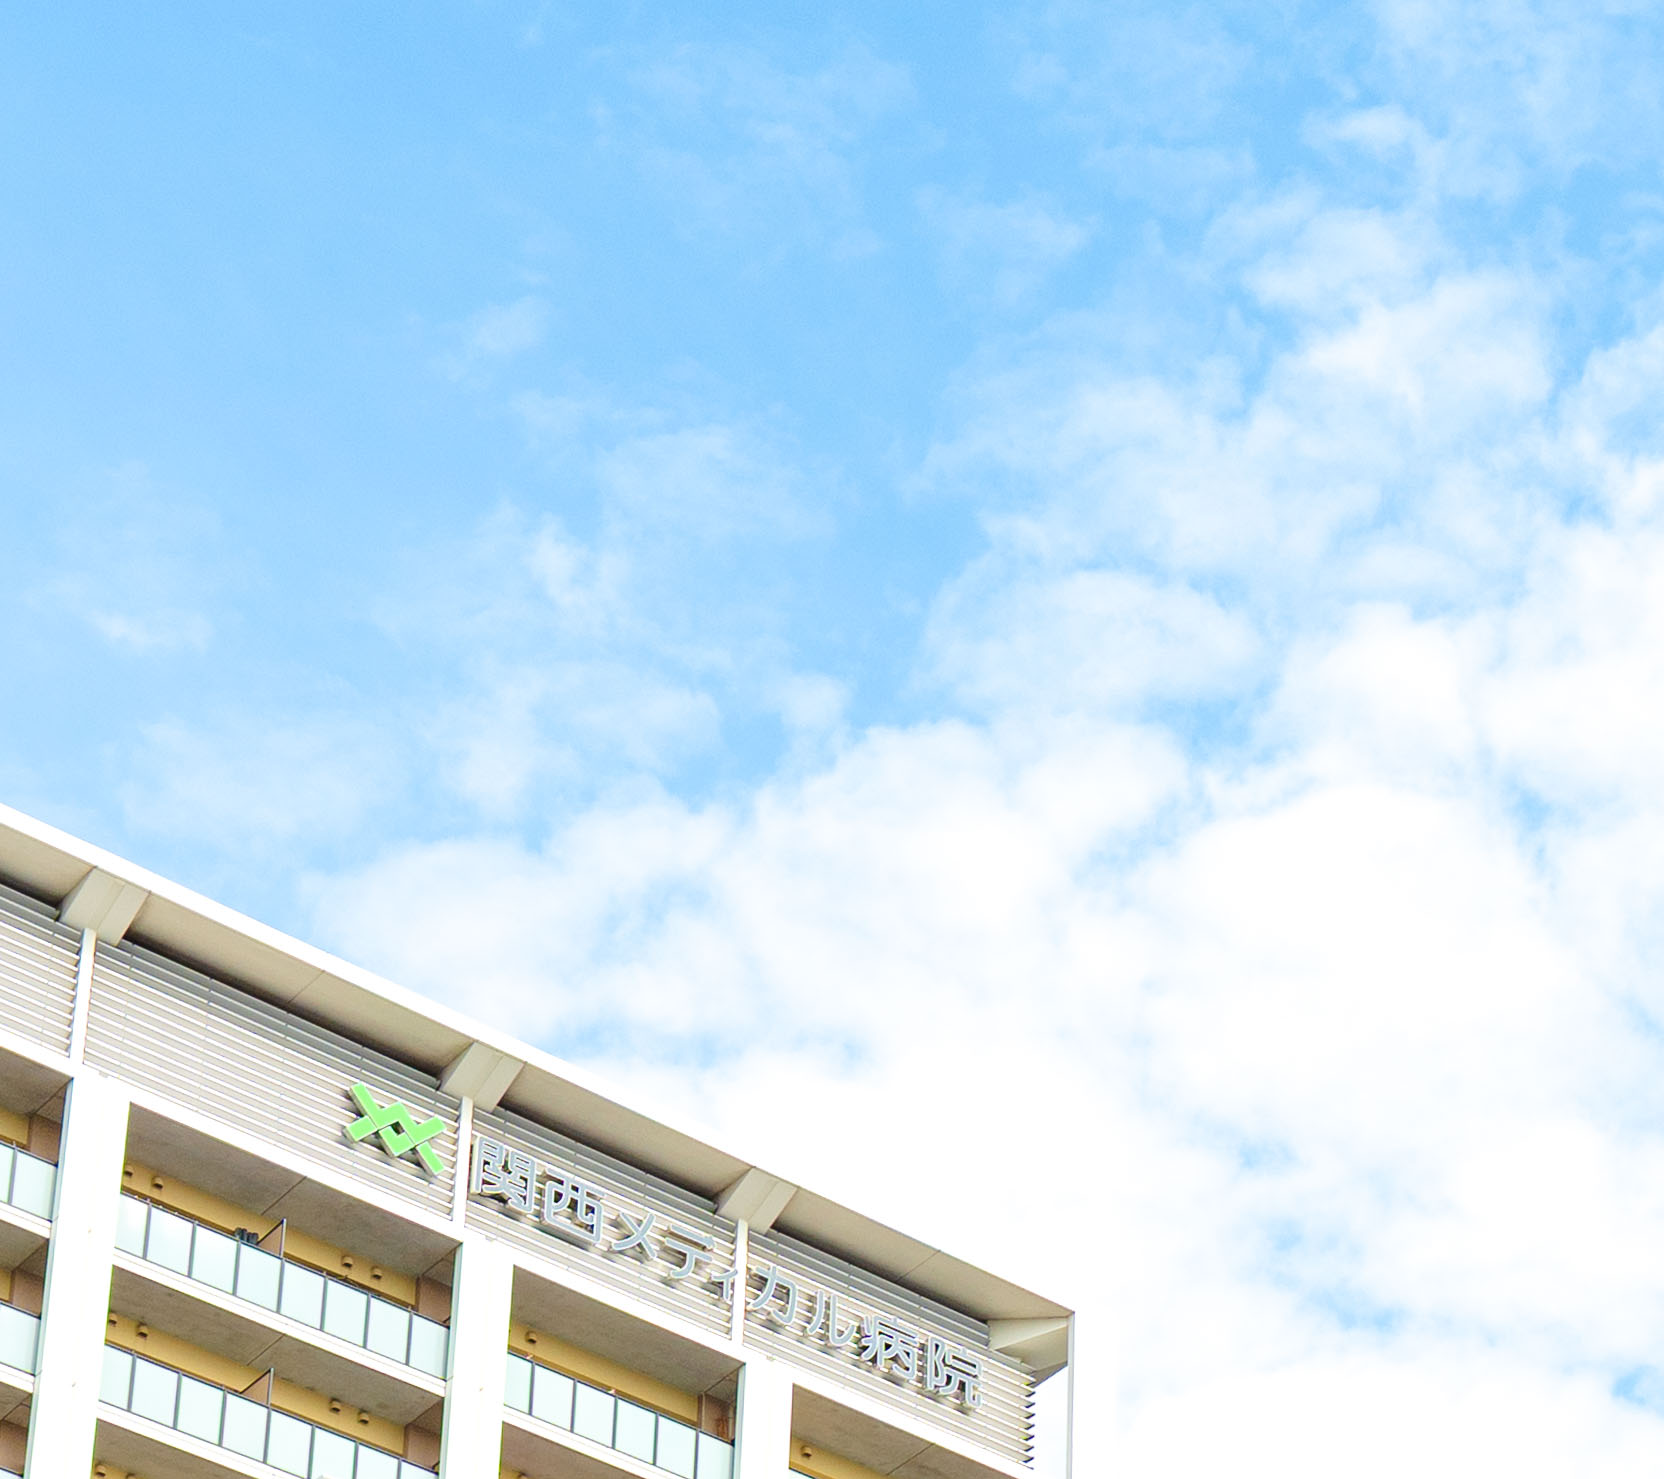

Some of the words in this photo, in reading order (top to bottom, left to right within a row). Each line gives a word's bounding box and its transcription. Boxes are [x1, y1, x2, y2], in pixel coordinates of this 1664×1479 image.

[471, 1135, 984, 1409] 関西メディカル病院
